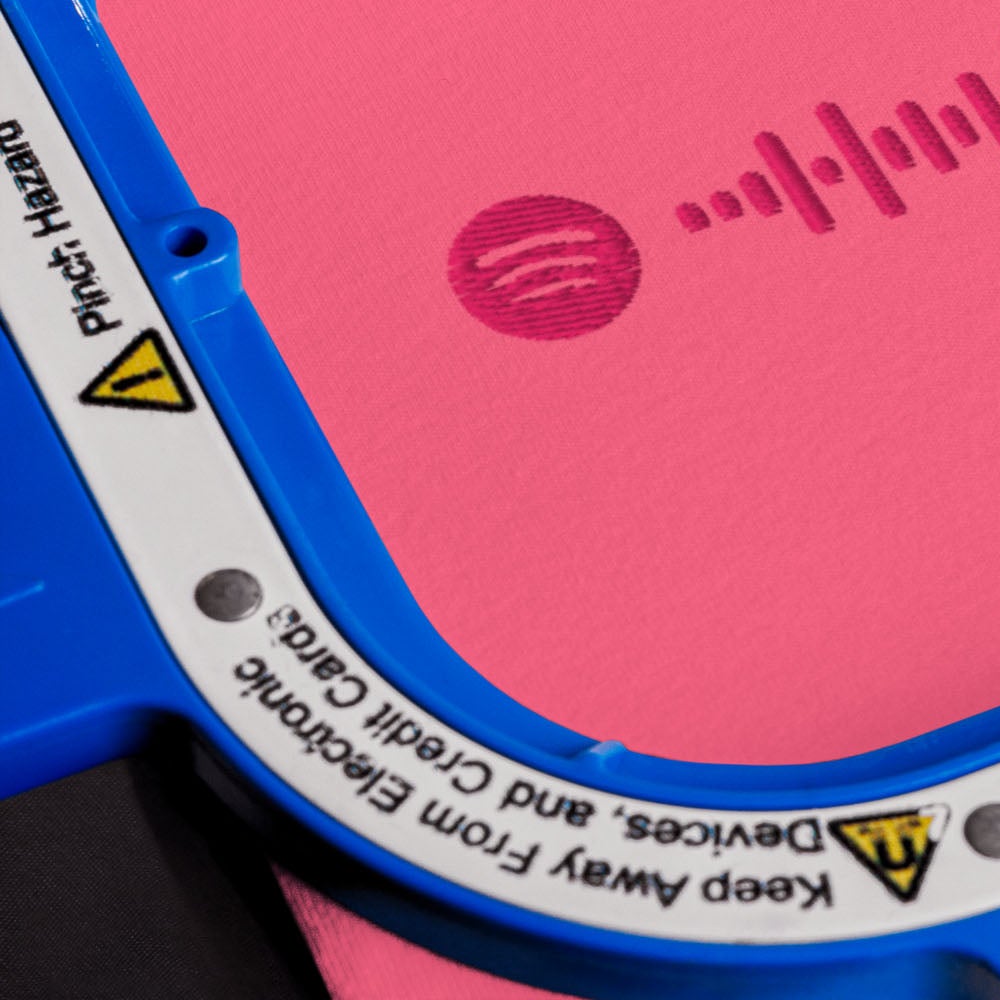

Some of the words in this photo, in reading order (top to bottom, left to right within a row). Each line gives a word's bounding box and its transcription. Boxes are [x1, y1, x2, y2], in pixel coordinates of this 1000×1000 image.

[232, 656, 416, 814] Electronic
[363, 702, 493, 795] Credit
[498, 779, 597, 828] and
[612, 805, 826, 857] Devices,
[418, 799, 541, 876] From
[548, 846, 689, 909] Away
[701, 868, 834, 910] Keep
